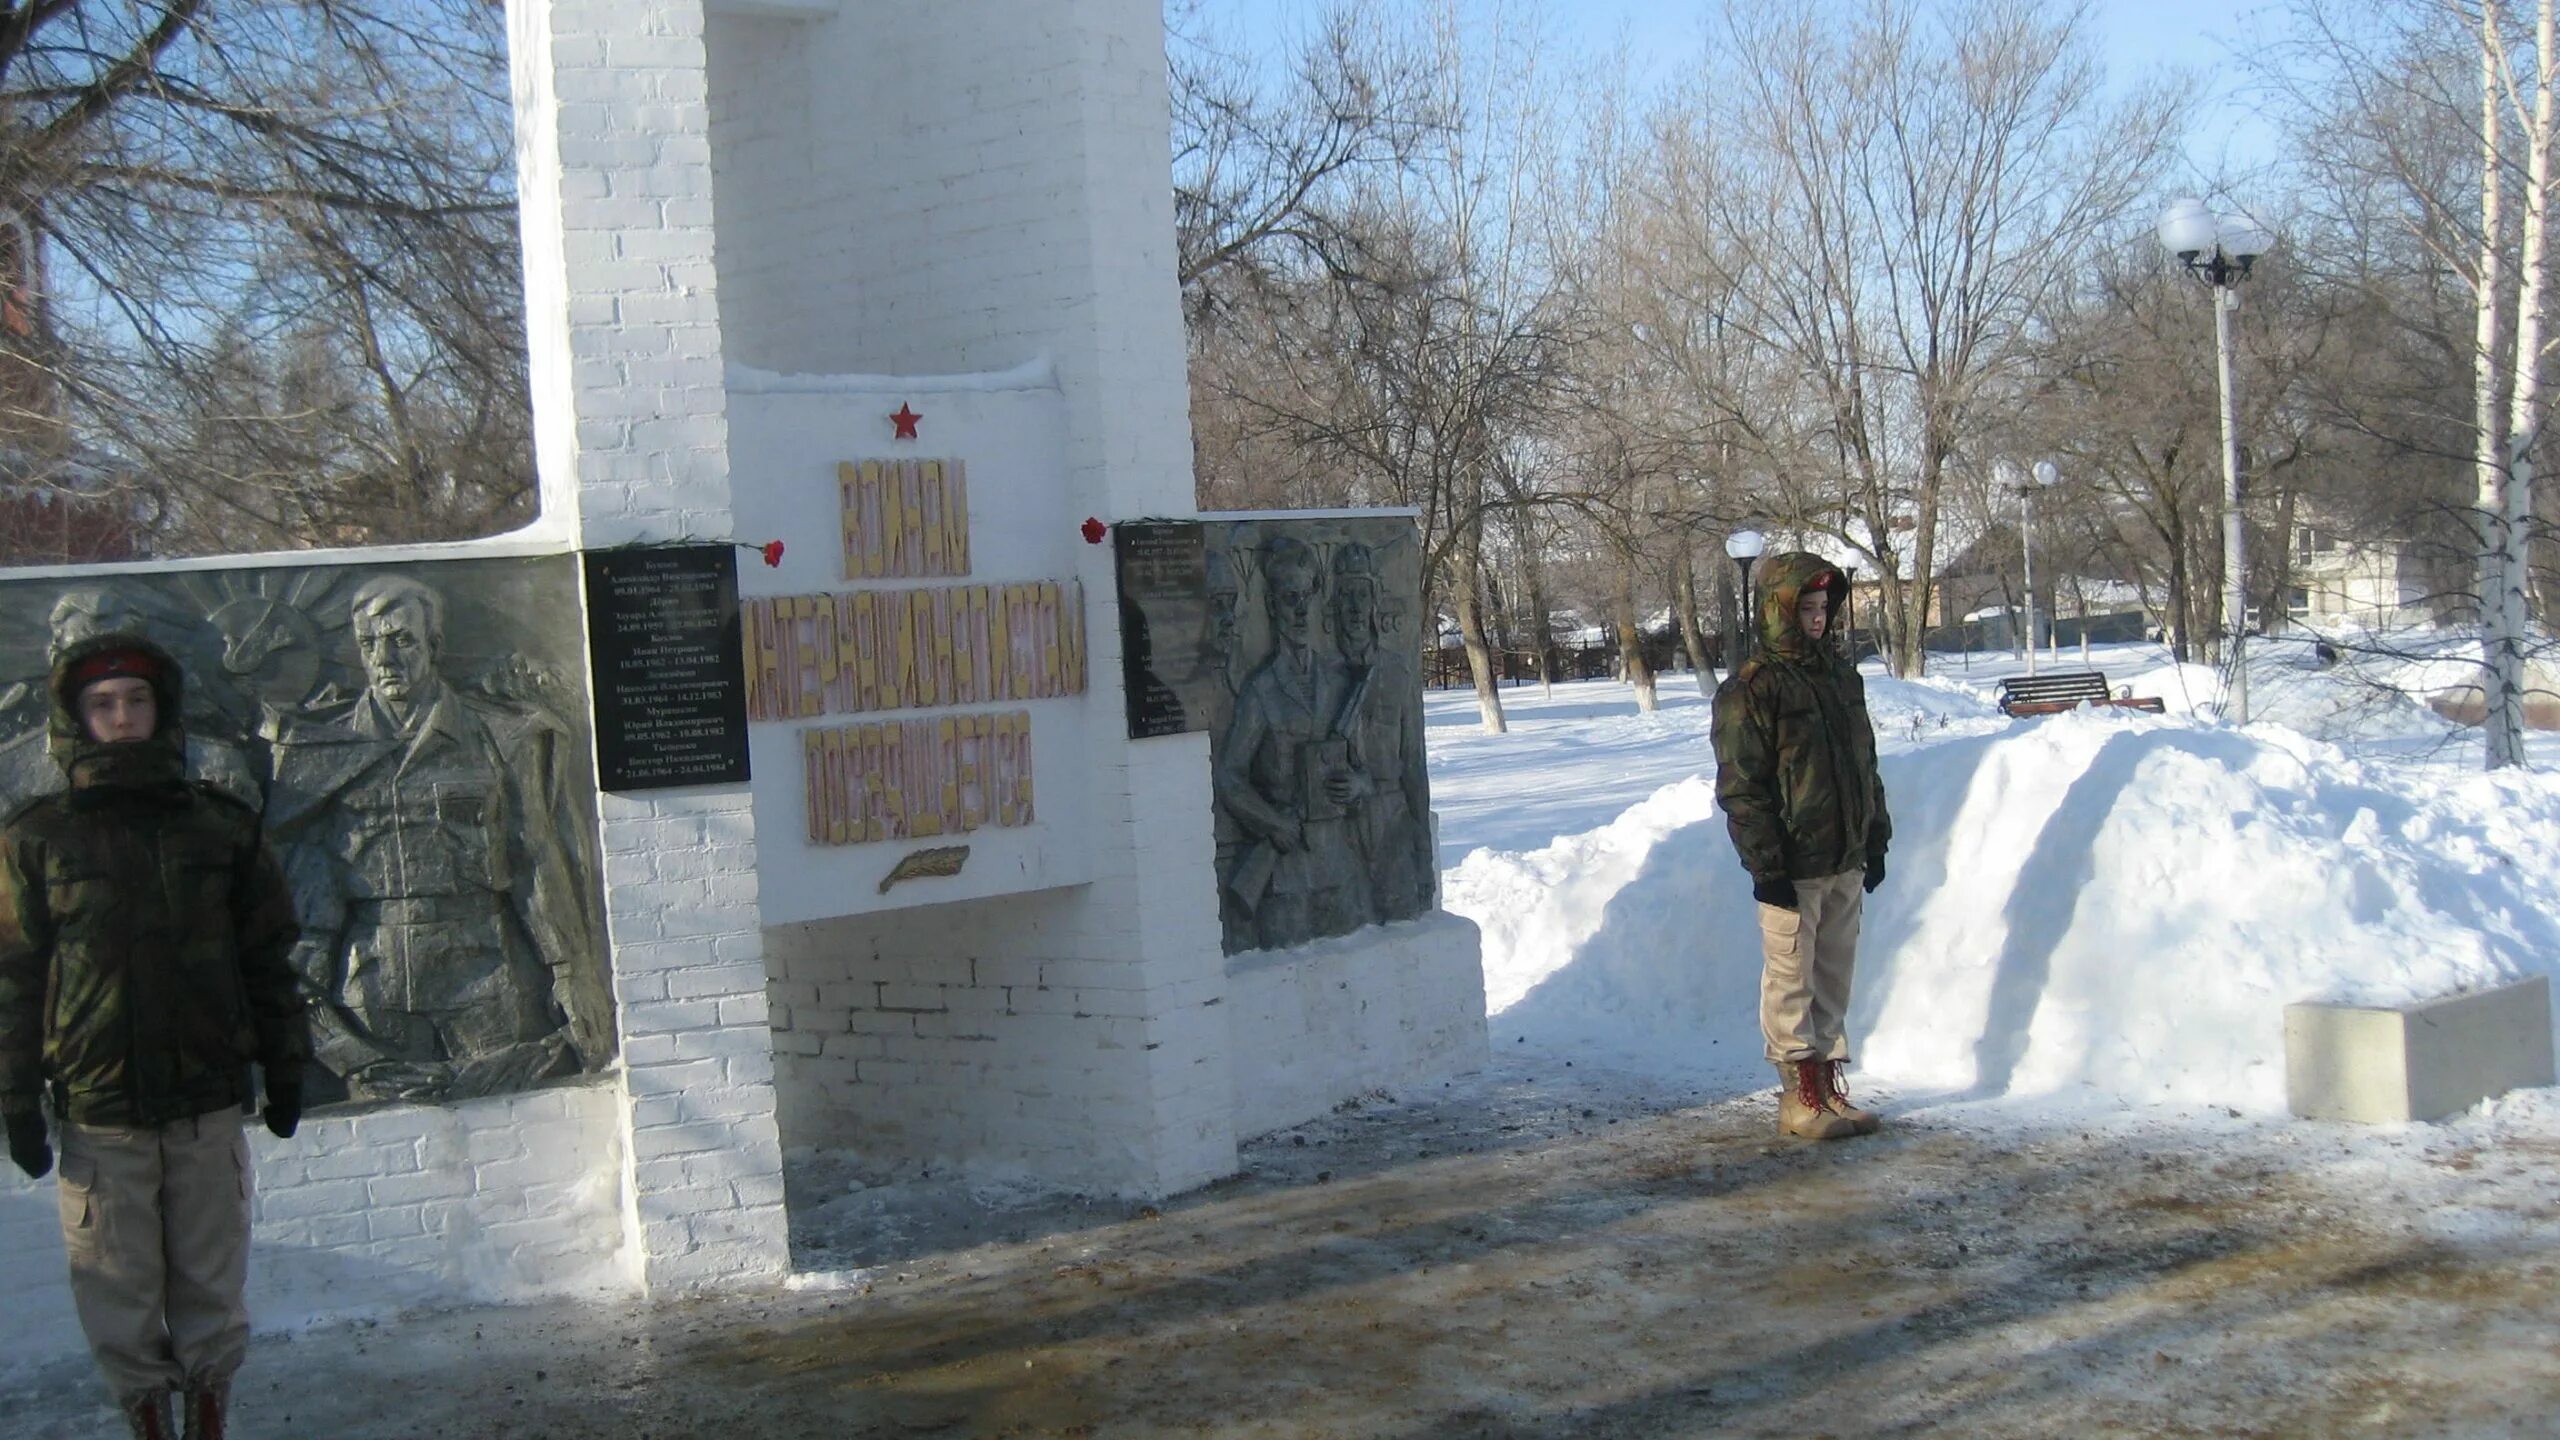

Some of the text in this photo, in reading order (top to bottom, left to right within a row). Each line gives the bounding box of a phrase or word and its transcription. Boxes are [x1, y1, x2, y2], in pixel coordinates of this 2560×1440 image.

[838, 460, 971, 579] ВОИНАМ
[633, 646, 705, 656] Иван Петрович
[742, 582, 1086, 721] ИНТЕРНАЦИОНАЛИСТАМ
[660, 681, 729, 691] Владимирович
[624, 717, 724, 731] Юрий Владимирович
[629, 757, 664, 767] Виктор
[805, 711, 1034, 845] ПОСВЯЩАЕТСЯ
